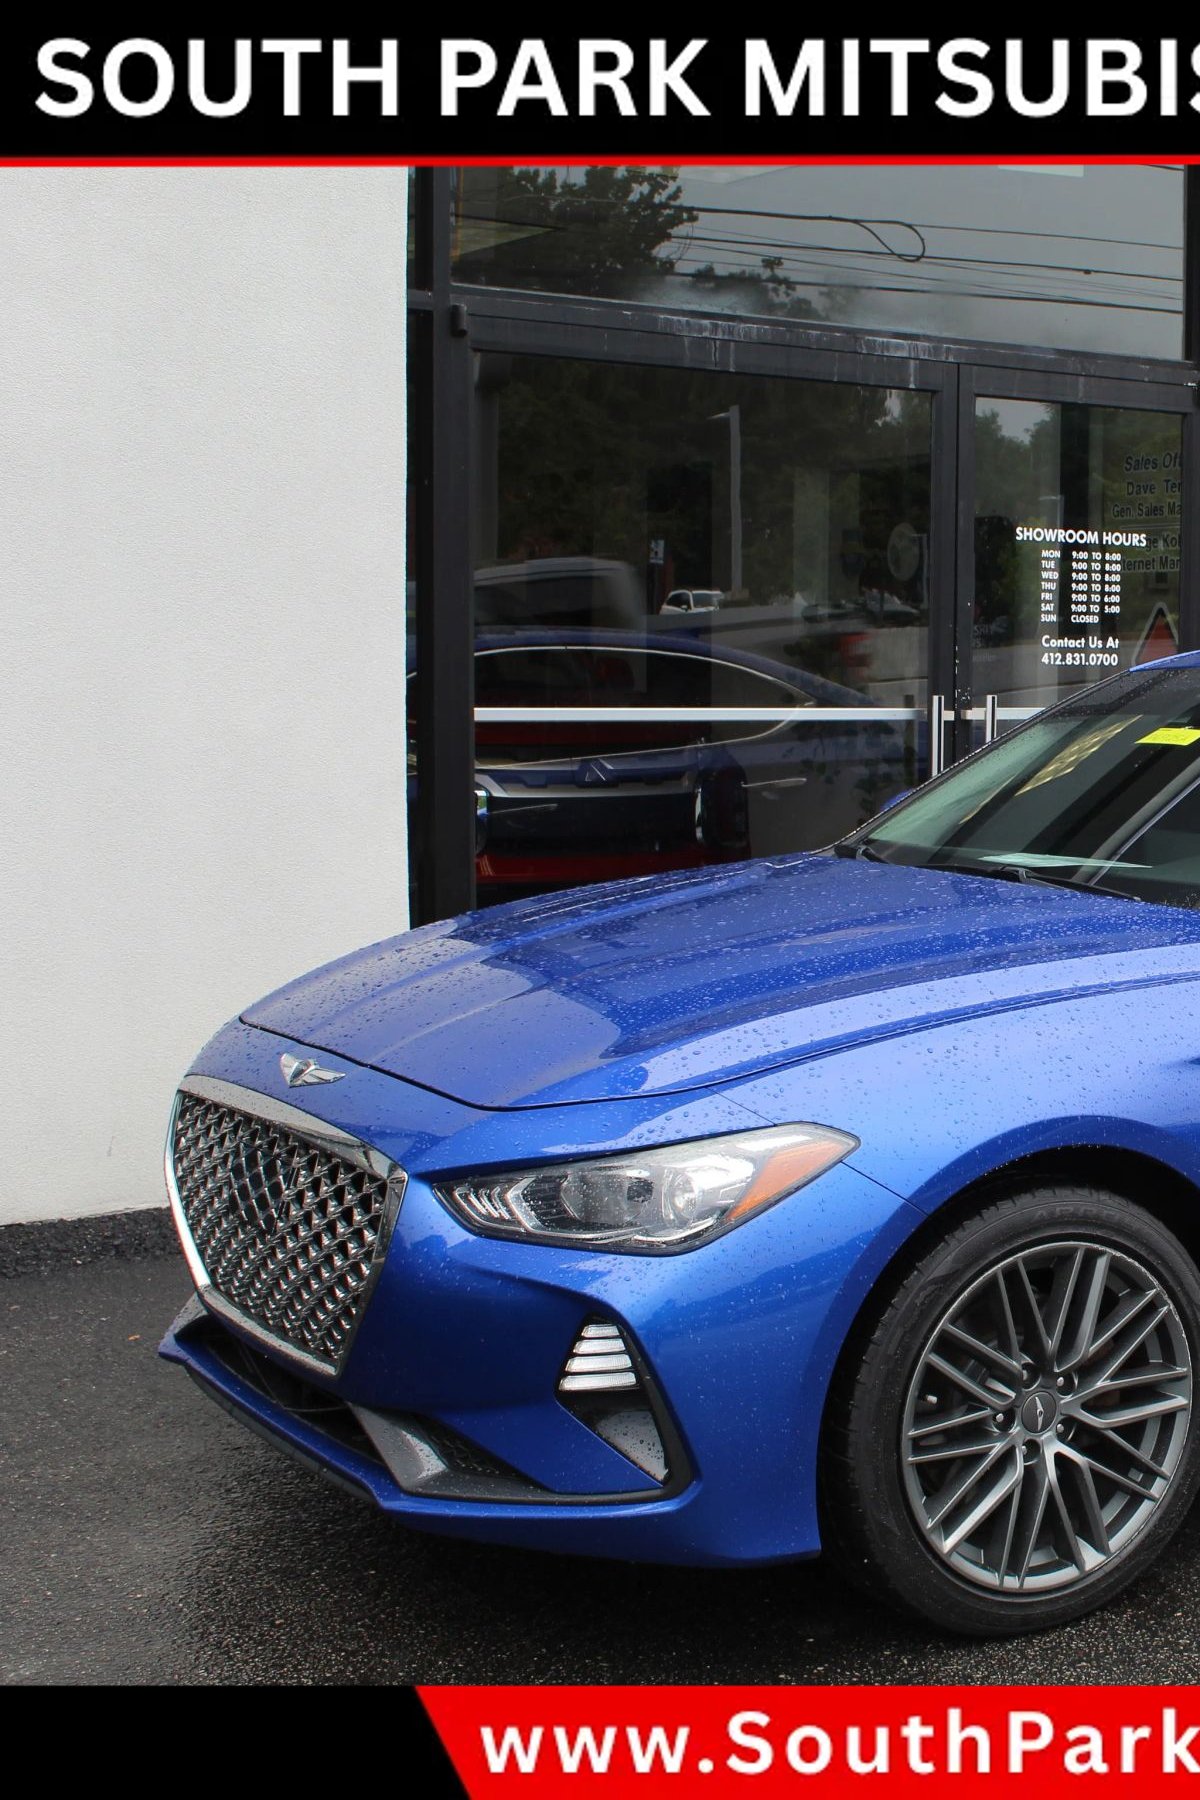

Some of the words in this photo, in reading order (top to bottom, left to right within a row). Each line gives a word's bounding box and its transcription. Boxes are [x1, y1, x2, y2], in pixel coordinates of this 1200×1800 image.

[1124, 457, 1159, 472] Sales
[1126, 482, 1157, 496] Dave
[1112, 504, 1134, 518] Gen.
[1137, 503, 1165, 517] Sales
[1015, 526, 1099, 544] SHOWROOM
[1102, 532, 1147, 547] HOURS
[1041, 550, 1061, 558] MON
[1071, 551, 1089, 560] 9:00
[1091, 552, 1102, 560] TO
[1104, 553, 1122, 561] 8:00
[1041, 561, 1056, 569] TUE
[1071, 562, 1088, 570] 9:00
[1091, 563, 1101, 571] TO
[1104, 564, 1121, 572] 8:00
[1041, 572, 1059, 580] WED
[1071, 572, 1088, 580] 9:00
[1091, 573, 1101, 581] TO
[1104, 574, 1121, 582] 8:00
[1041, 582, 1057, 590] THU
[1071, 583, 1088, 591] 9:00
[1091, 584, 1101, 592] TO
[1104, 585, 1121, 593] 8:00
[1071, 594, 1087, 602] 9:00
[1104, 595, 1120, 603] 6:00
[1041, 603, 1054, 611] SAT
[1070, 604, 1087, 612] 9:00
[1090, 605, 1100, 613] TO
[1104, 606, 1120, 614] 5:00
[1041, 614, 1057, 622] SUN
[1070, 615, 1099, 623] CLOSED
[1041, 635, 1086, 648] Contact
[1088, 636, 1103, 649] Us
[1105, 637, 1120, 649] At
[1041, 652, 1119, 666] 412.831.0700
